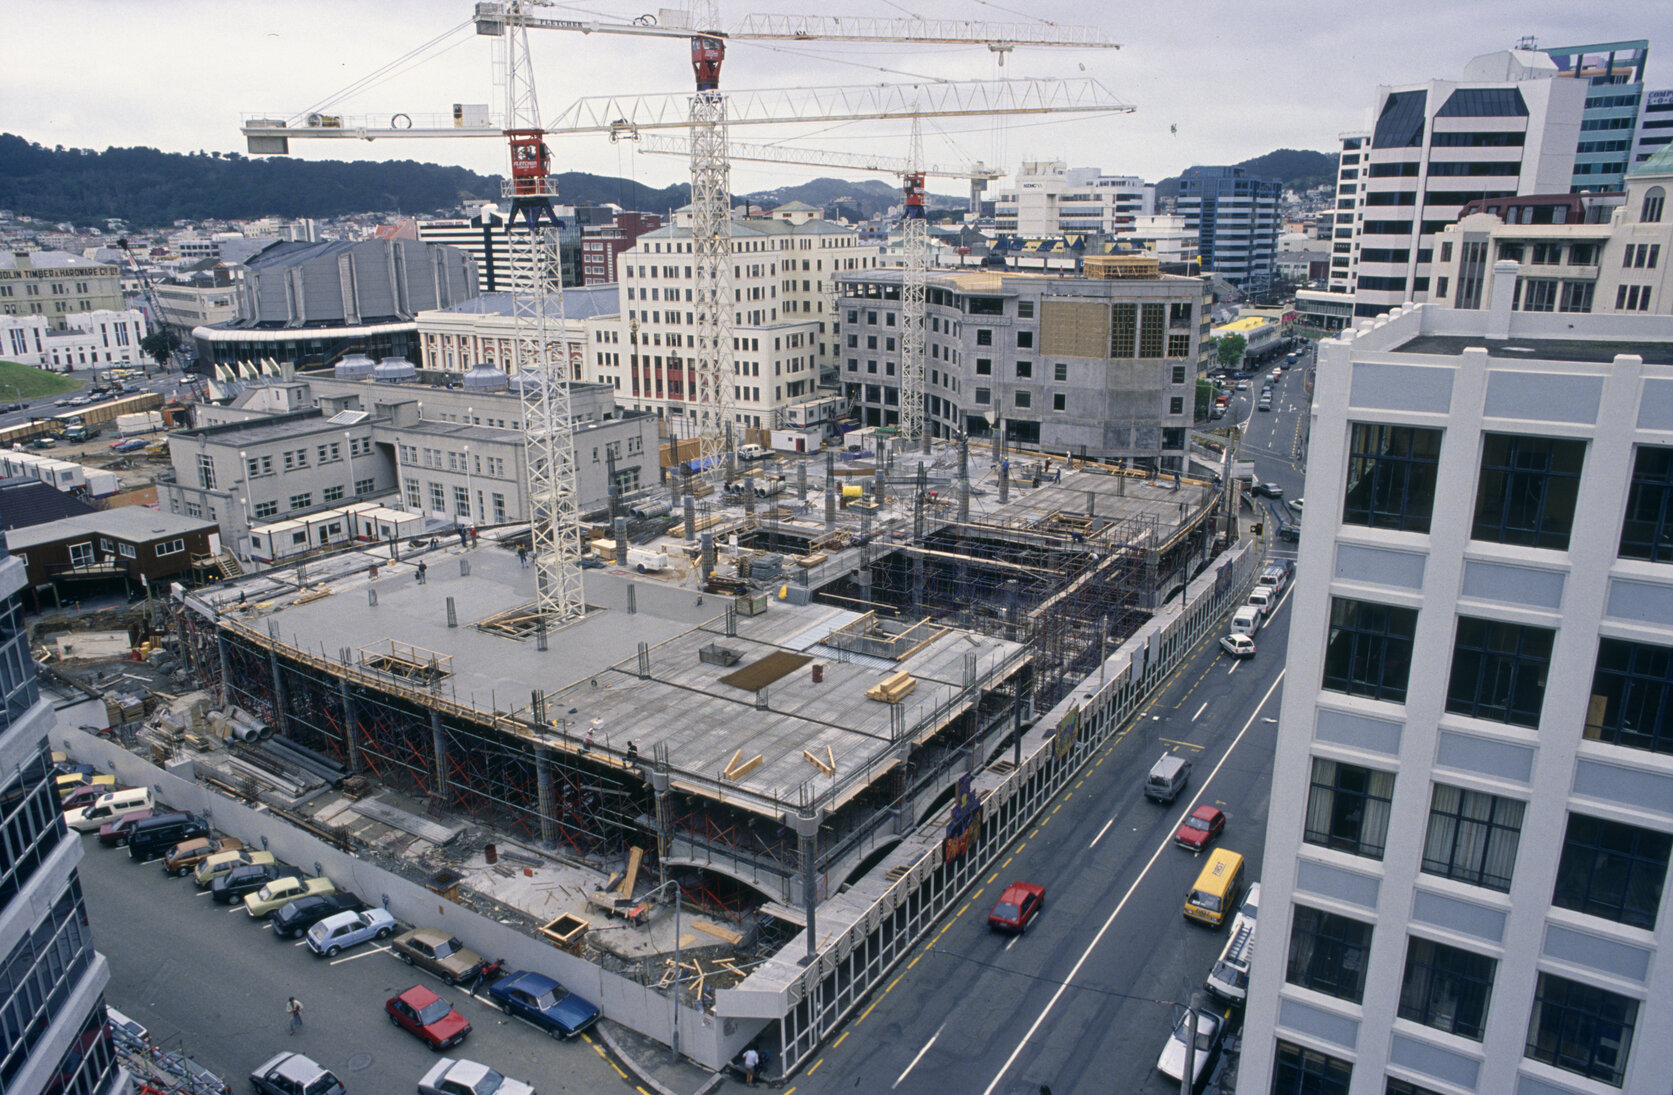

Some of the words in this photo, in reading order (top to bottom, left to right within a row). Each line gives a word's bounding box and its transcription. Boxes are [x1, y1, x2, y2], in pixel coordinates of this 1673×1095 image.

[540, 19, 582, 28] FLETCHER
[1648, 90, 1673, 98] COMP
[24, 269, 54, 279] TIMBER
[60, 268, 98, 278] HARDWARE
